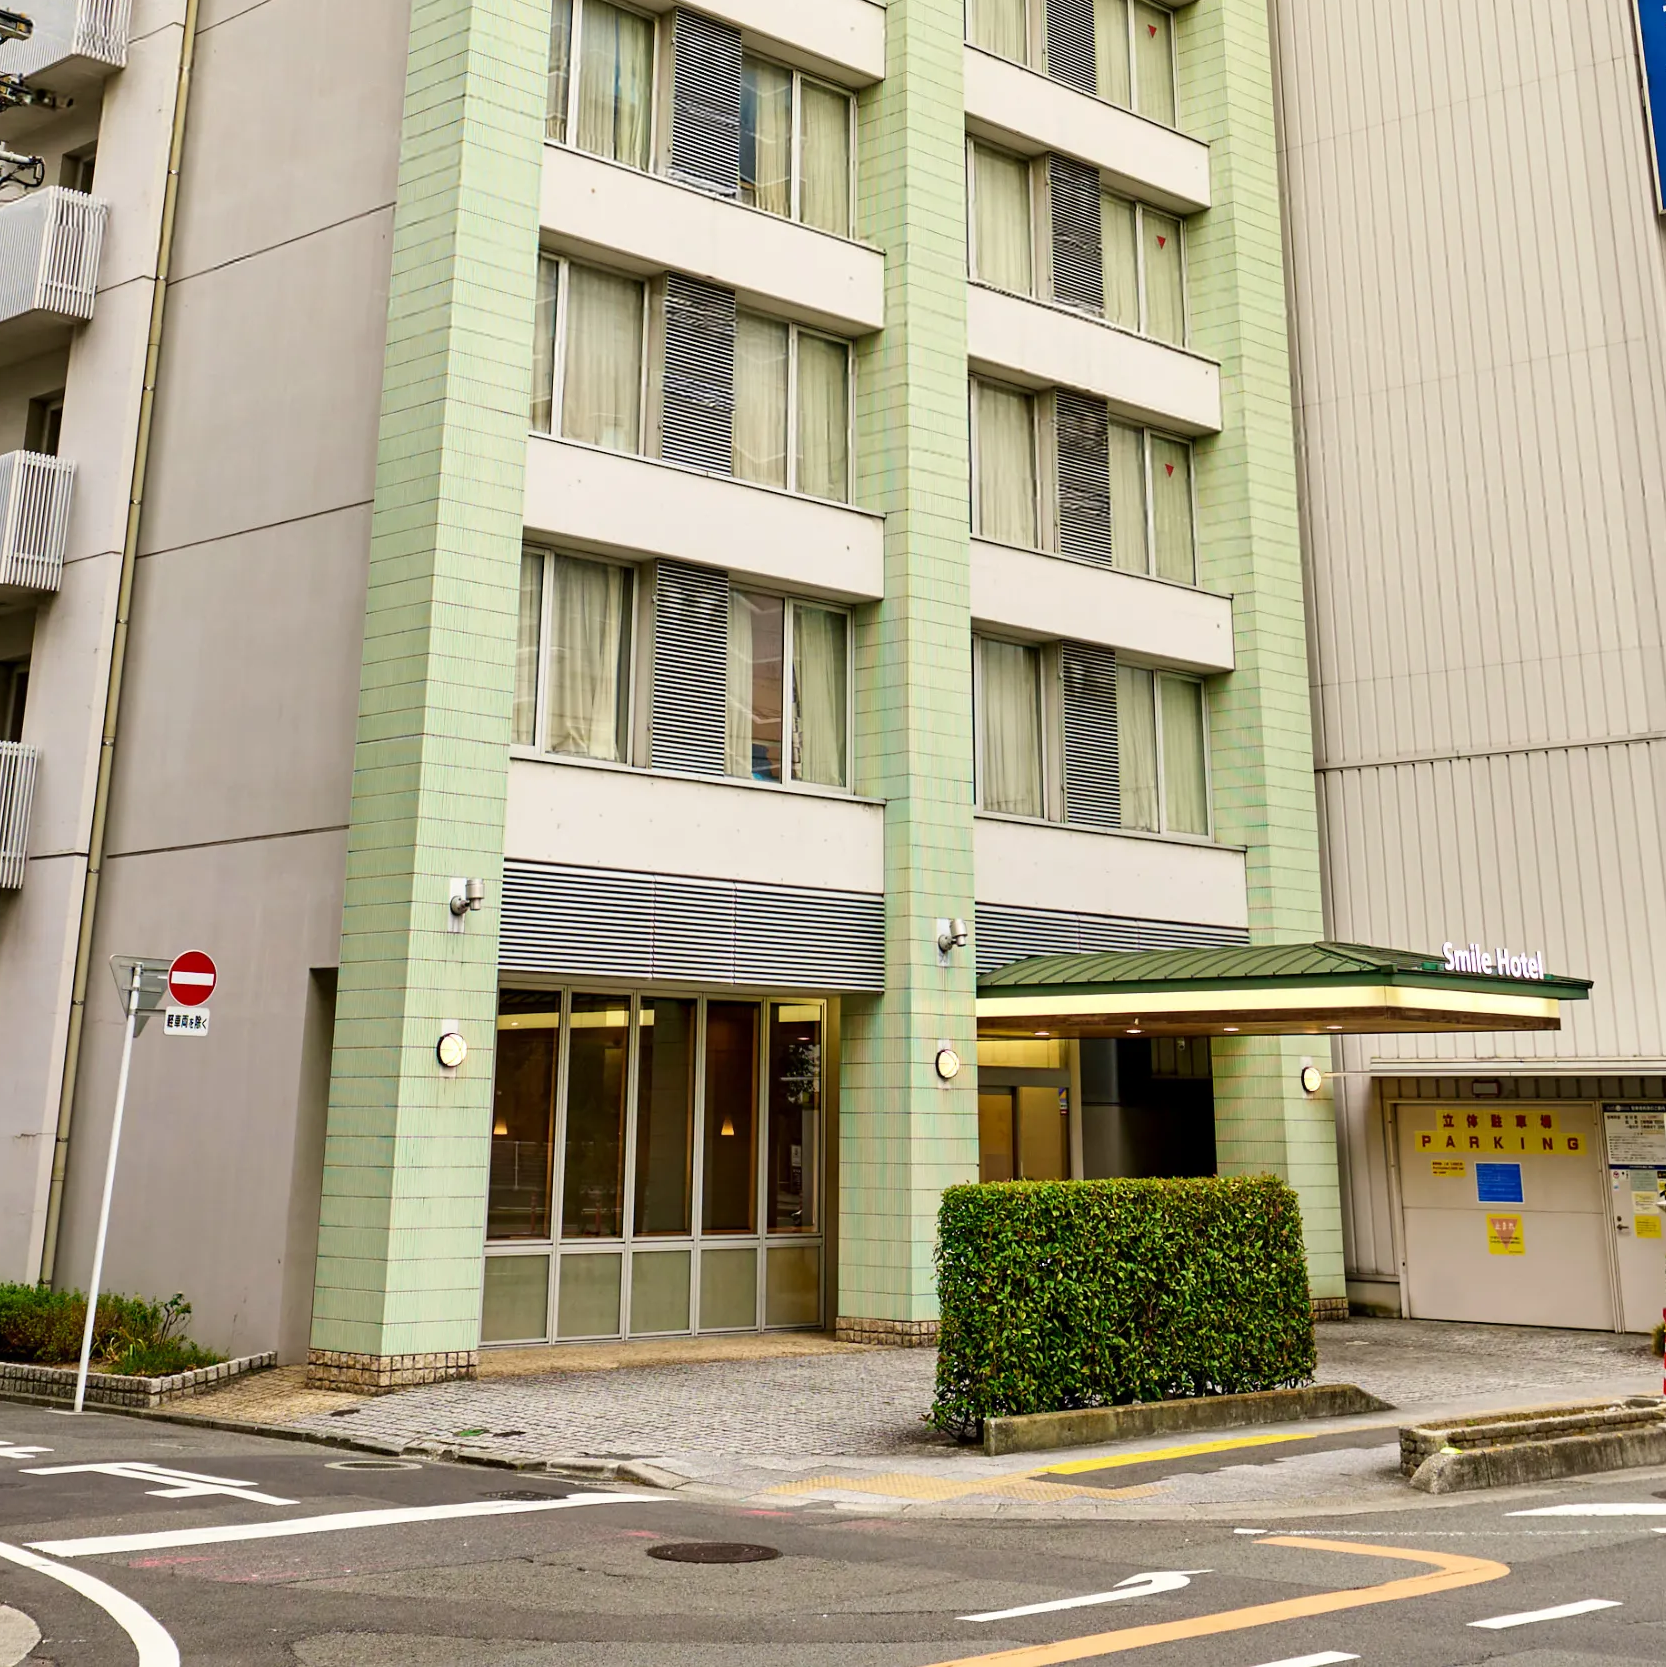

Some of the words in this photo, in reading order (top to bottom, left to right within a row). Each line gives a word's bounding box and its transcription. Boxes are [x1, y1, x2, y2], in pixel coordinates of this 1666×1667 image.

[1442, 941, 1493, 974] Smile
[1495, 947, 1544, 980] Hotel
[167, 1014, 208, 1029] 軽車両を除く
[1442, 1114, 1552, 1129] 立体駐車場
[1421, 1135, 1579, 1150] PARKING
